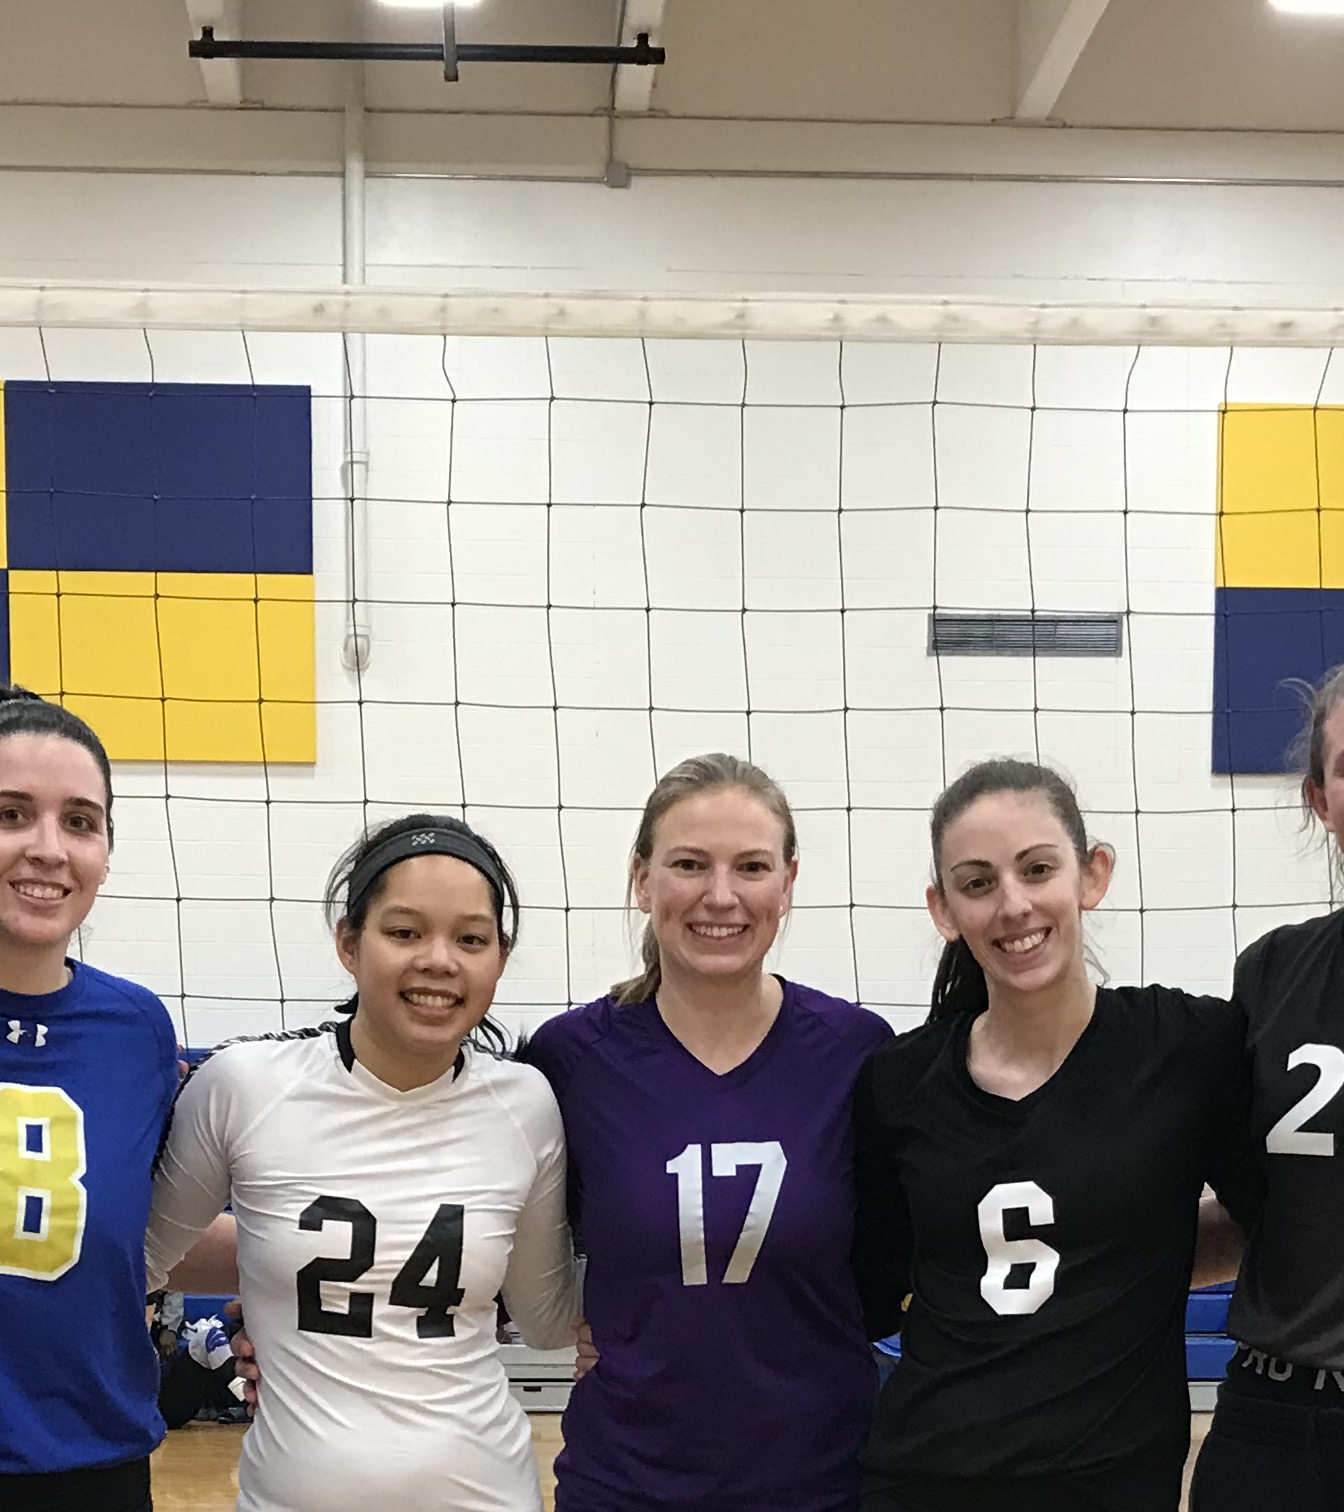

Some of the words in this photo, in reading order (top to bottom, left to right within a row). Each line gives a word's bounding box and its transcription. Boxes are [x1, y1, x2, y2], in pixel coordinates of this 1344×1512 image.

[296, 1194, 466, 1339] 24
[665, 1140, 788, 1287] 17
[977, 1180, 1061, 1316] 6
